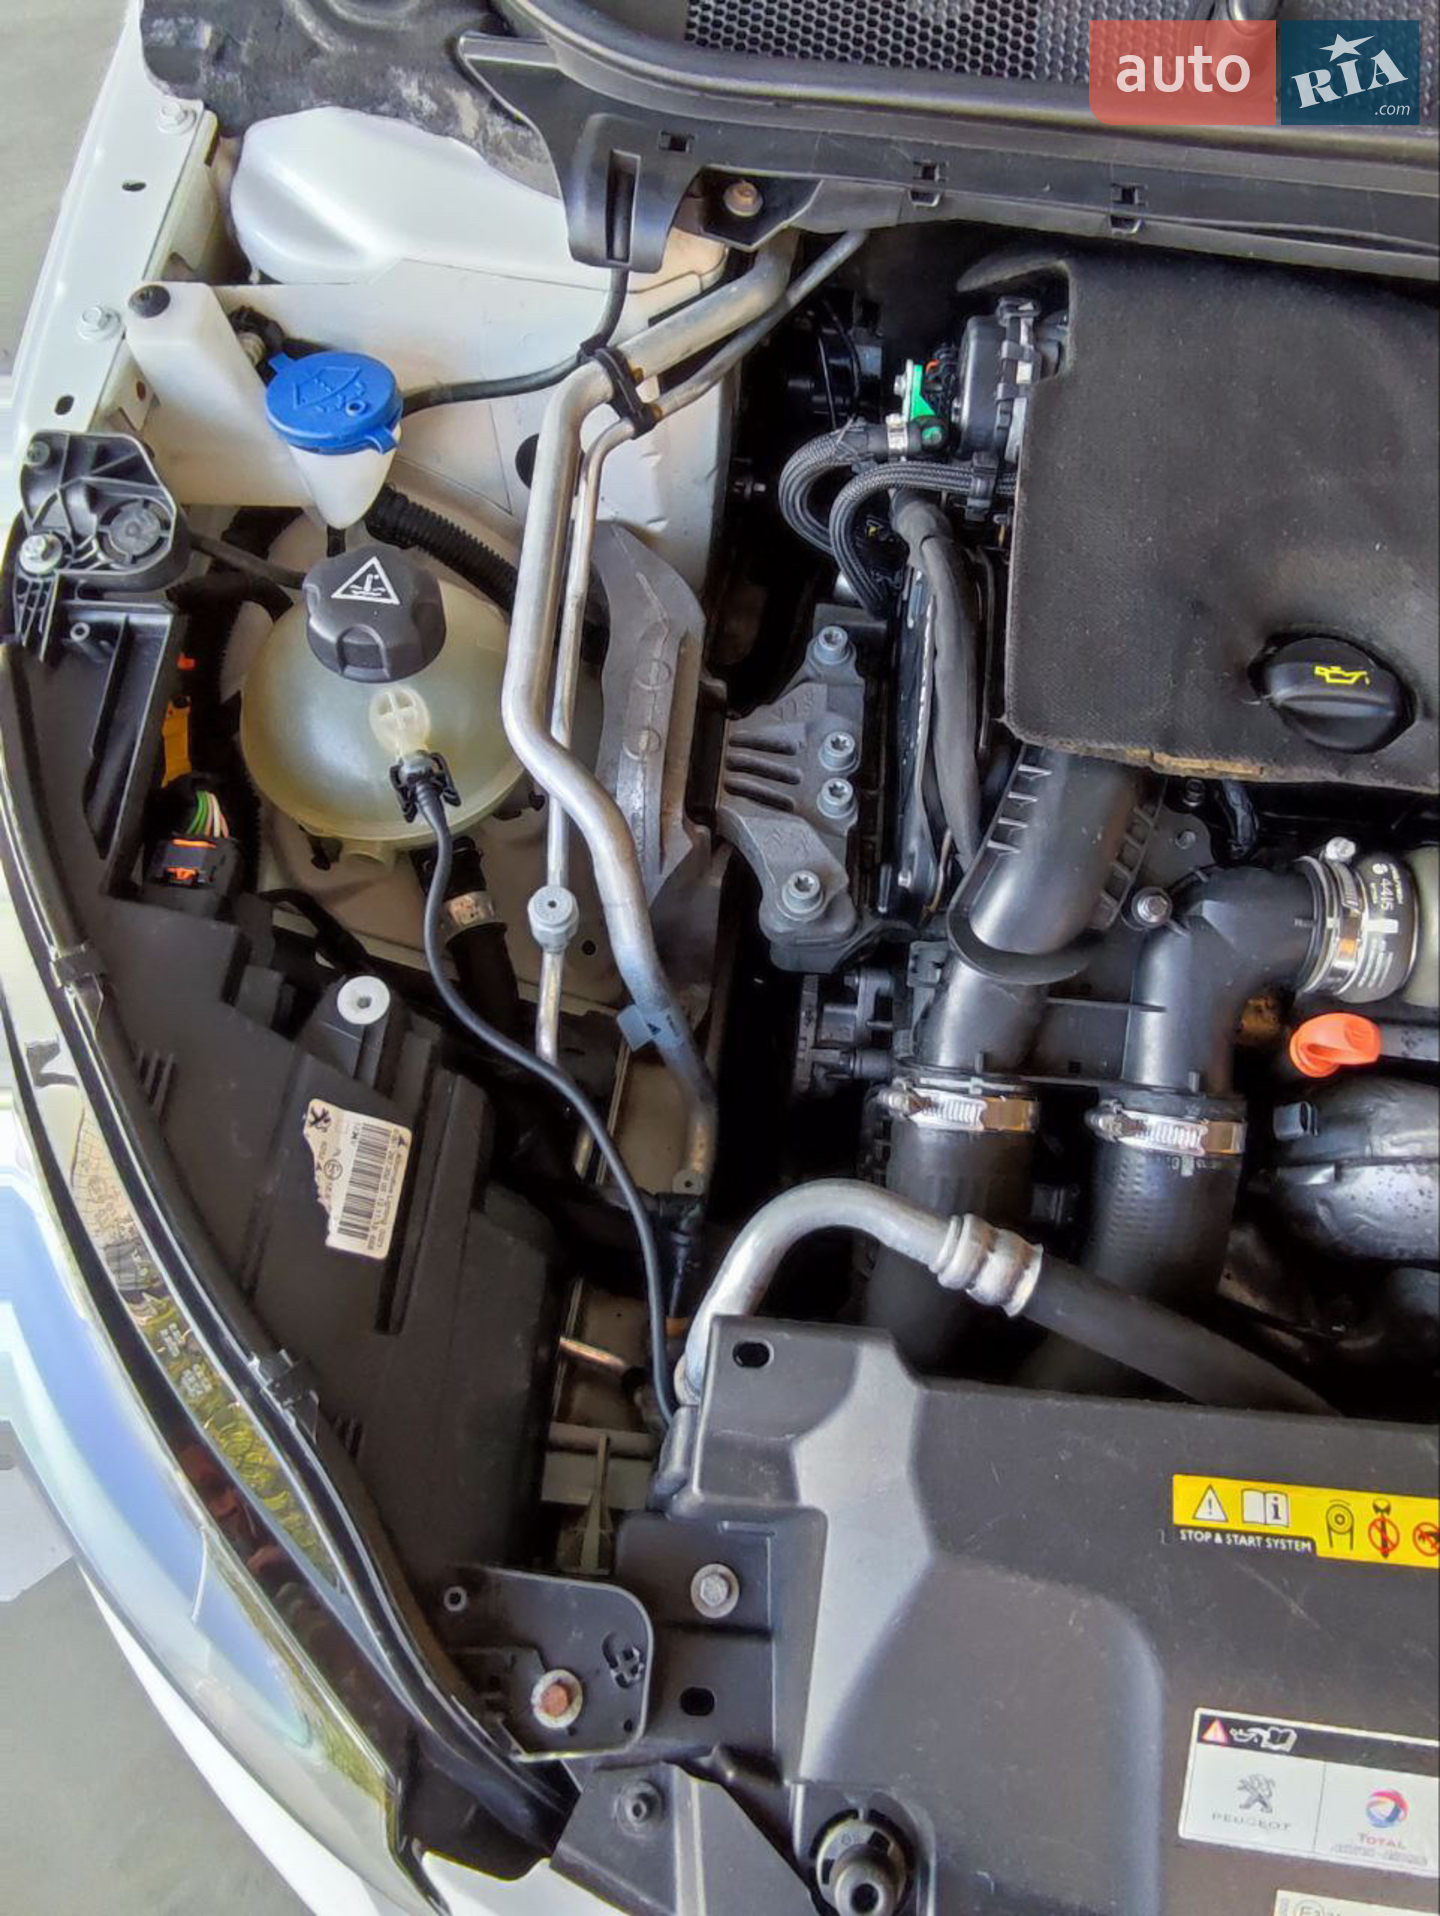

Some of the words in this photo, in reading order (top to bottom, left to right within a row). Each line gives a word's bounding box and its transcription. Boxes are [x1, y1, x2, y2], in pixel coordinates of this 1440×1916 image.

[1380, 878, 1393, 911] 4415
[1179, 1529, 1212, 1543] STOP
[1214, 1534, 1223, 1544] &
[1225, 1534, 1262, 1548] START
[1265, 1538, 1312, 1553] SYSTEM
[1211, 1812, 1293, 1831] PEUGEOT
[1357, 1832, 1406, 1849] TOTAL
